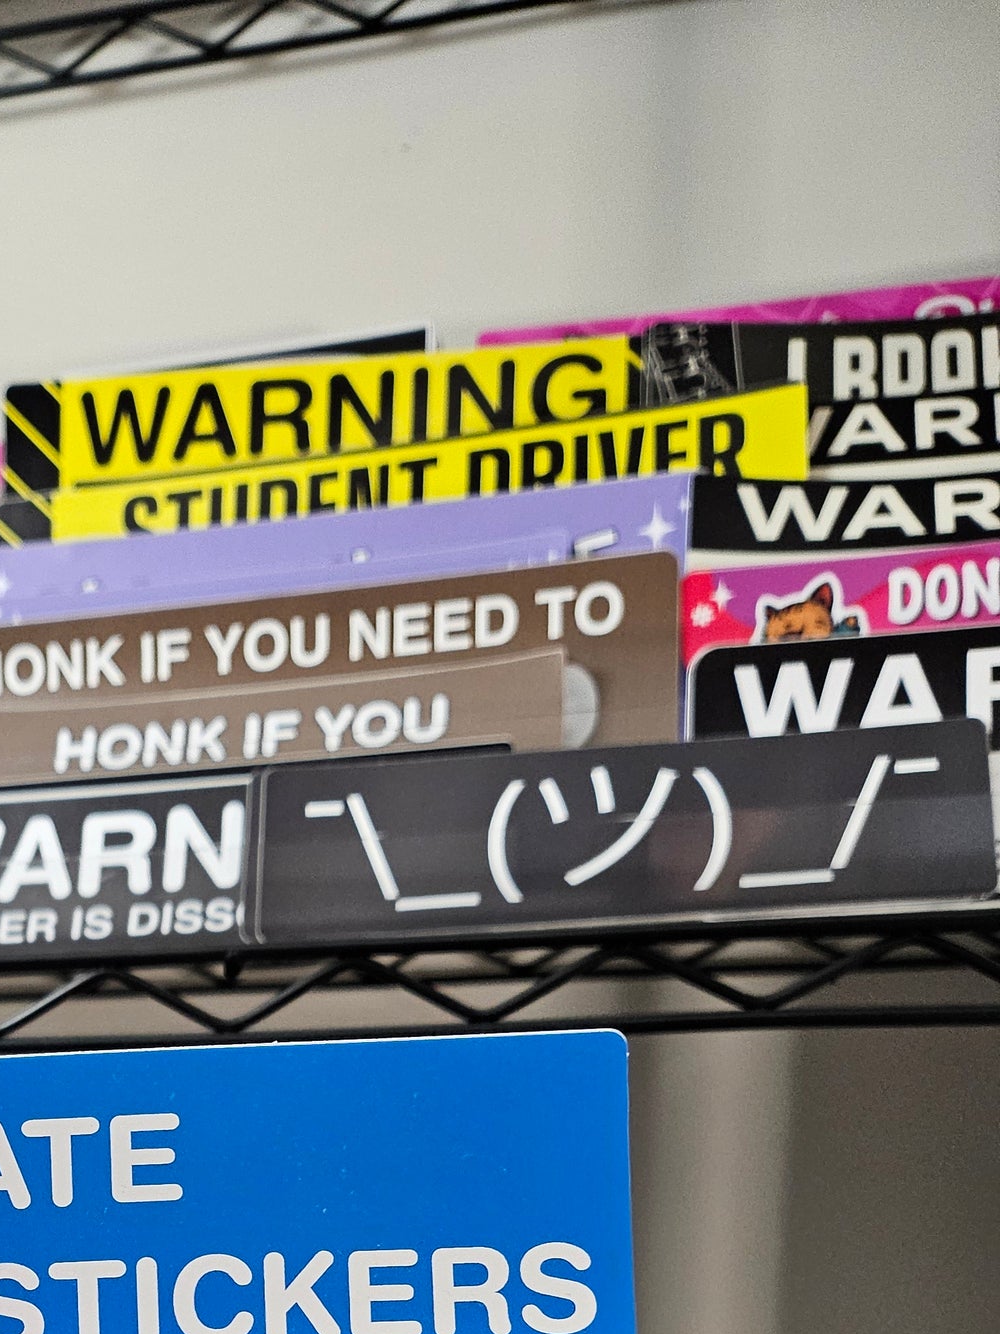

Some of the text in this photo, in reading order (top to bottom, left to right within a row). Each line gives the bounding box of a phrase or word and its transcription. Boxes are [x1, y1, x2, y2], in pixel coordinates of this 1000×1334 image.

[81, 350, 606, 470] WARNING
[466, 412, 746, 498] DRIVER
[140, 628, 193, 684] IF
[205, 612, 332, 677] YOU
[349, 592, 520, 663] NEED
[533, 580, 626, 641] TO
[54, 693, 452, 774] HONK IF YOU
[70, 903, 112, 942] IS
